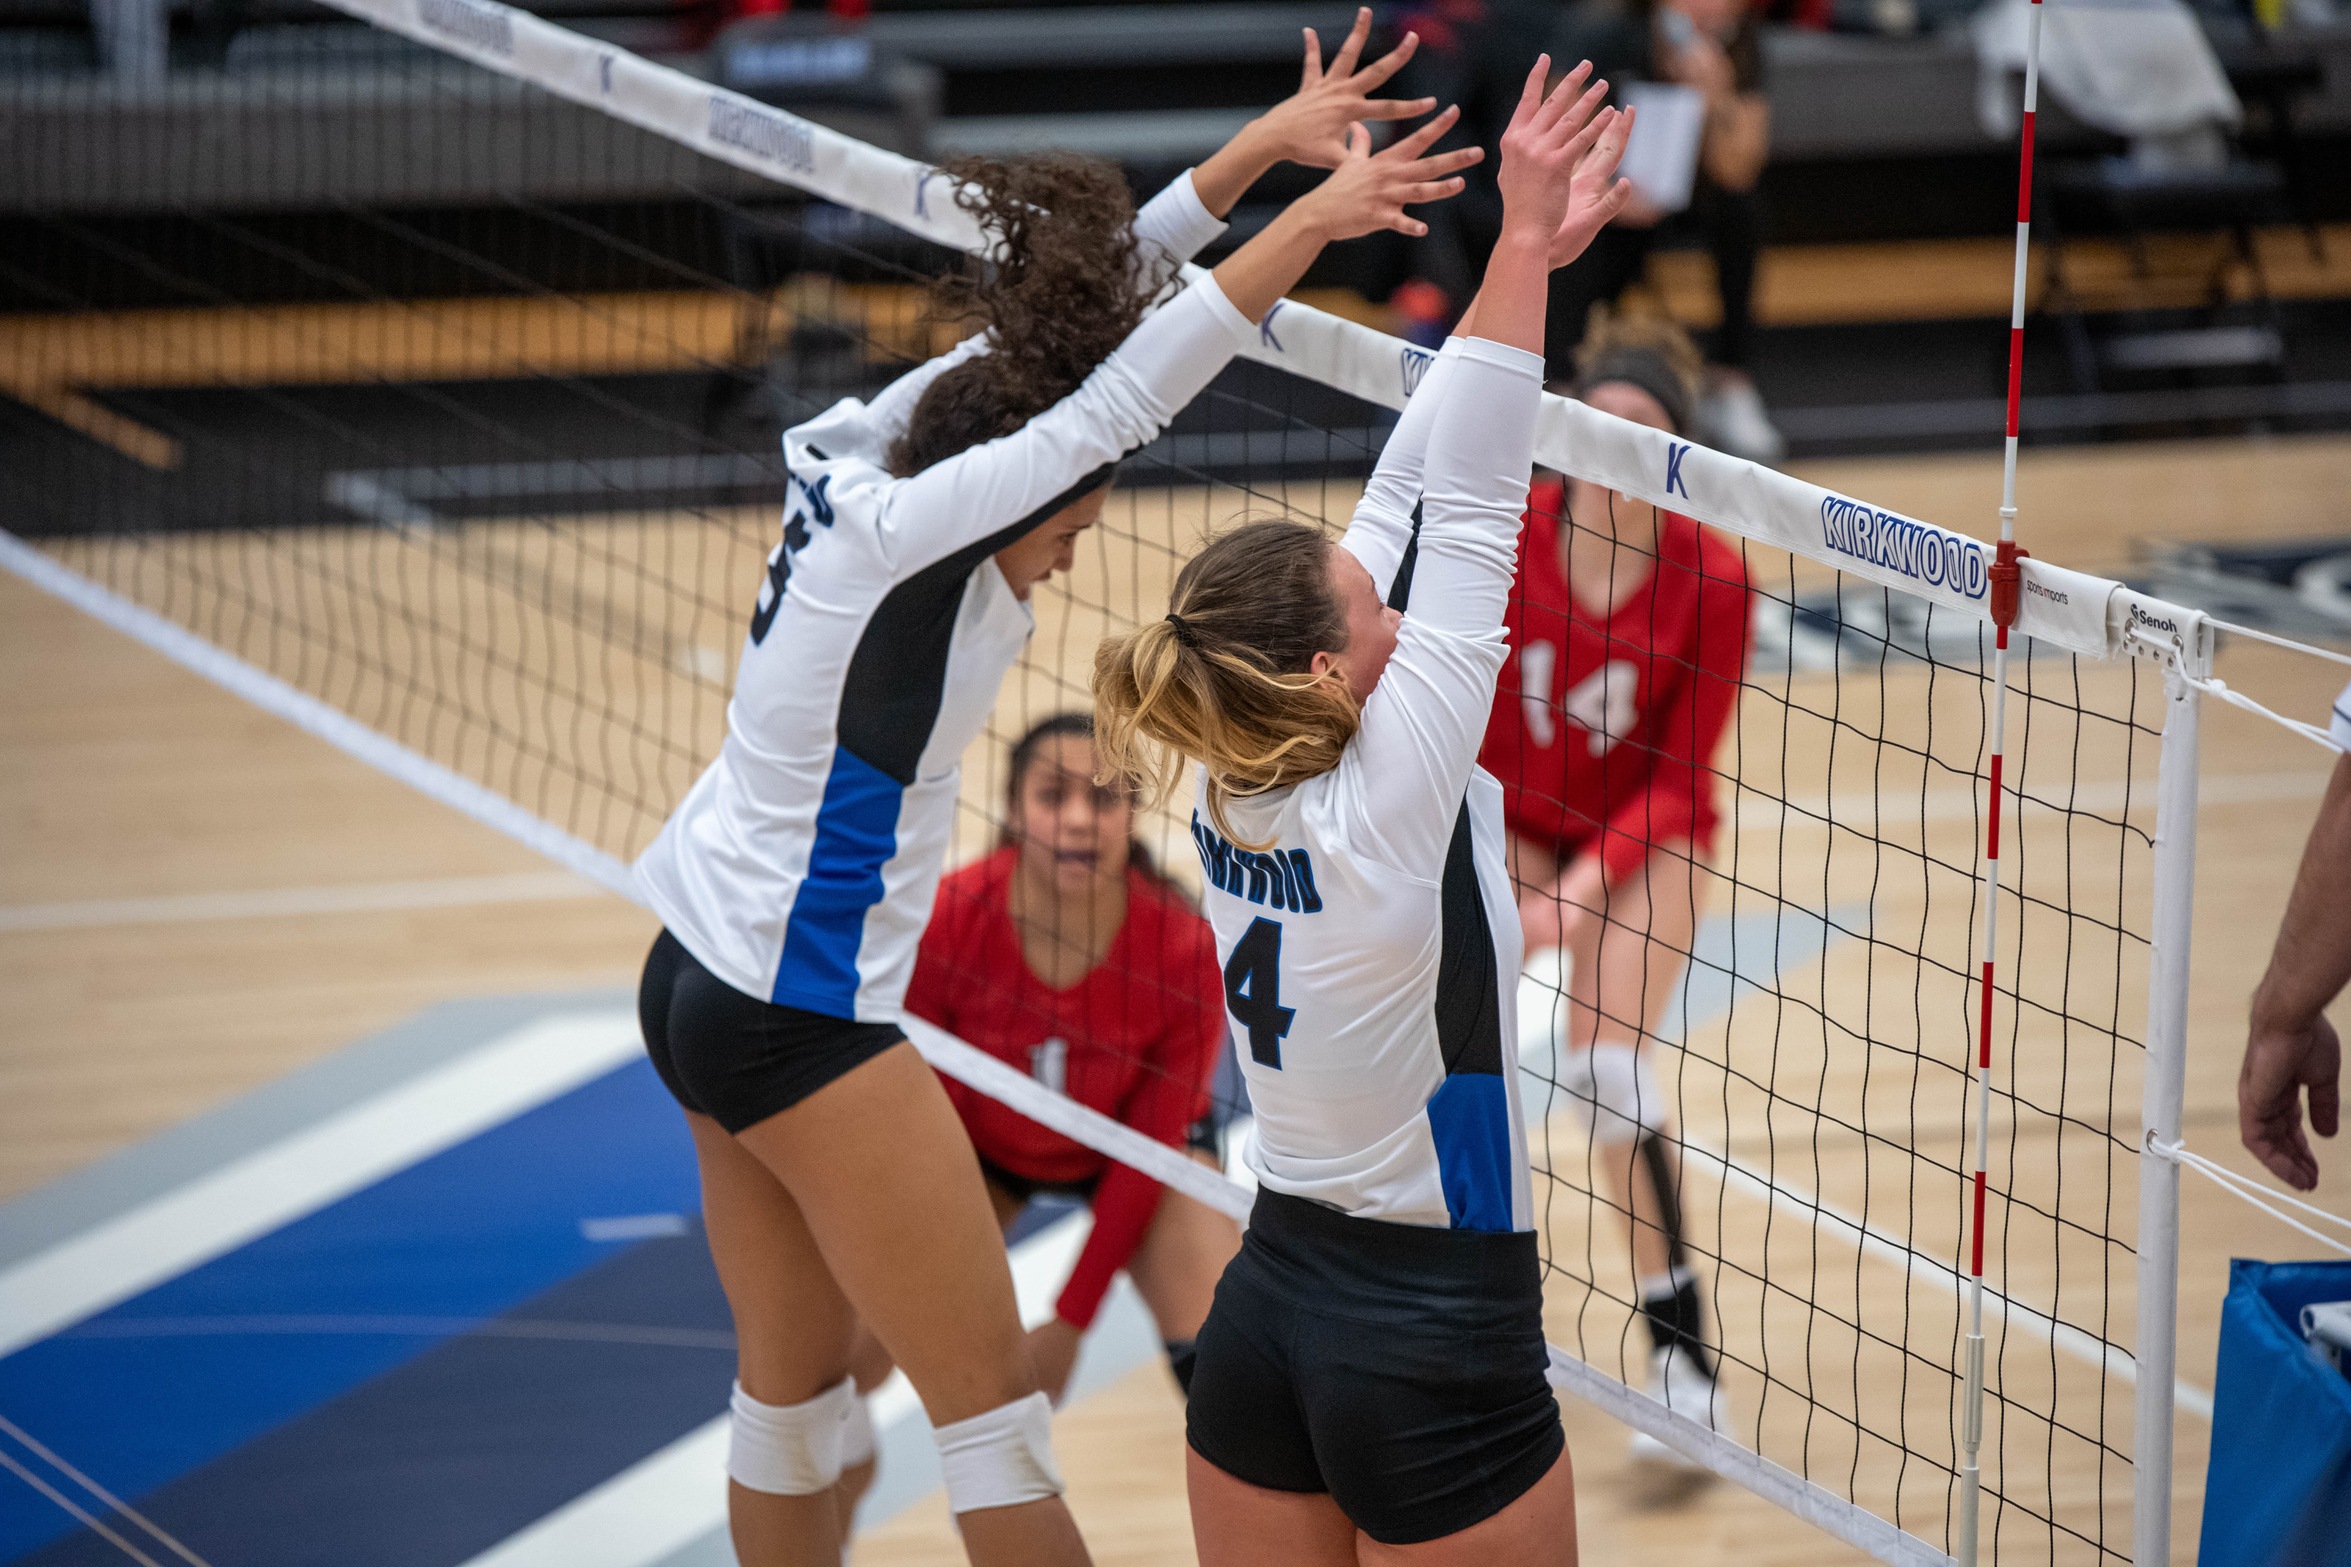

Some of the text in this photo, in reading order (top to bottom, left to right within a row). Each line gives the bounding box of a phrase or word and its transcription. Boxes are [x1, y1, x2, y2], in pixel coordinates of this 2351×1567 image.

[1666, 441, 1692, 499] K
[1821, 495, 1988, 600] KIRKWOOD
[2139, 609, 2178, 634] Senoh
[1515, 637, 1640, 759] 14
[1223, 915, 1297, 1072] 4
